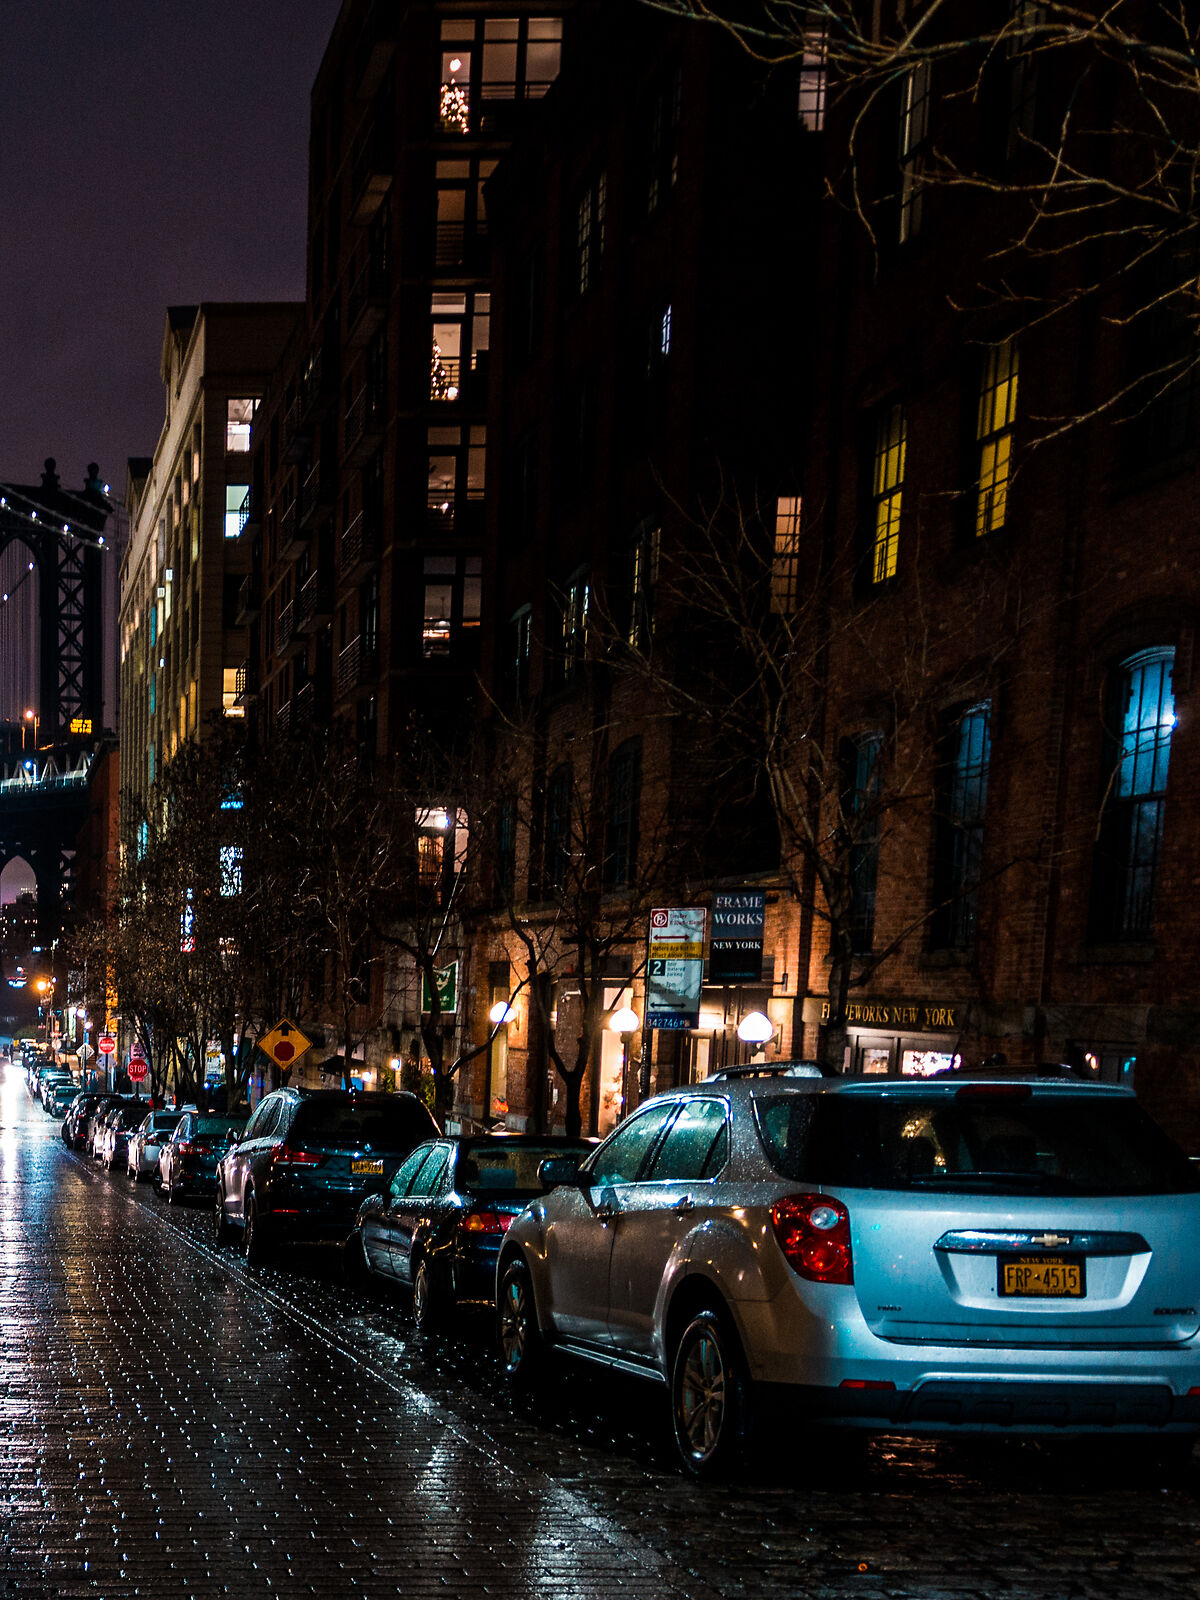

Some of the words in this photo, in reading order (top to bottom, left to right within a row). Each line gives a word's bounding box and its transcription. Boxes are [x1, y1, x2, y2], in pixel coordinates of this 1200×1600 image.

[716, 896, 762, 908] FRAME
[714, 913, 763, 925] WORKS
[712, 941, 733, 949] NEW
[735, 941, 761, 949] YORK
[652, 961, 662, 975] 2
[821, 1003, 889, 1022] FEWORKS
[893, 1007, 918, 1024] NEW
[924, 1008, 955, 1026] YORK
